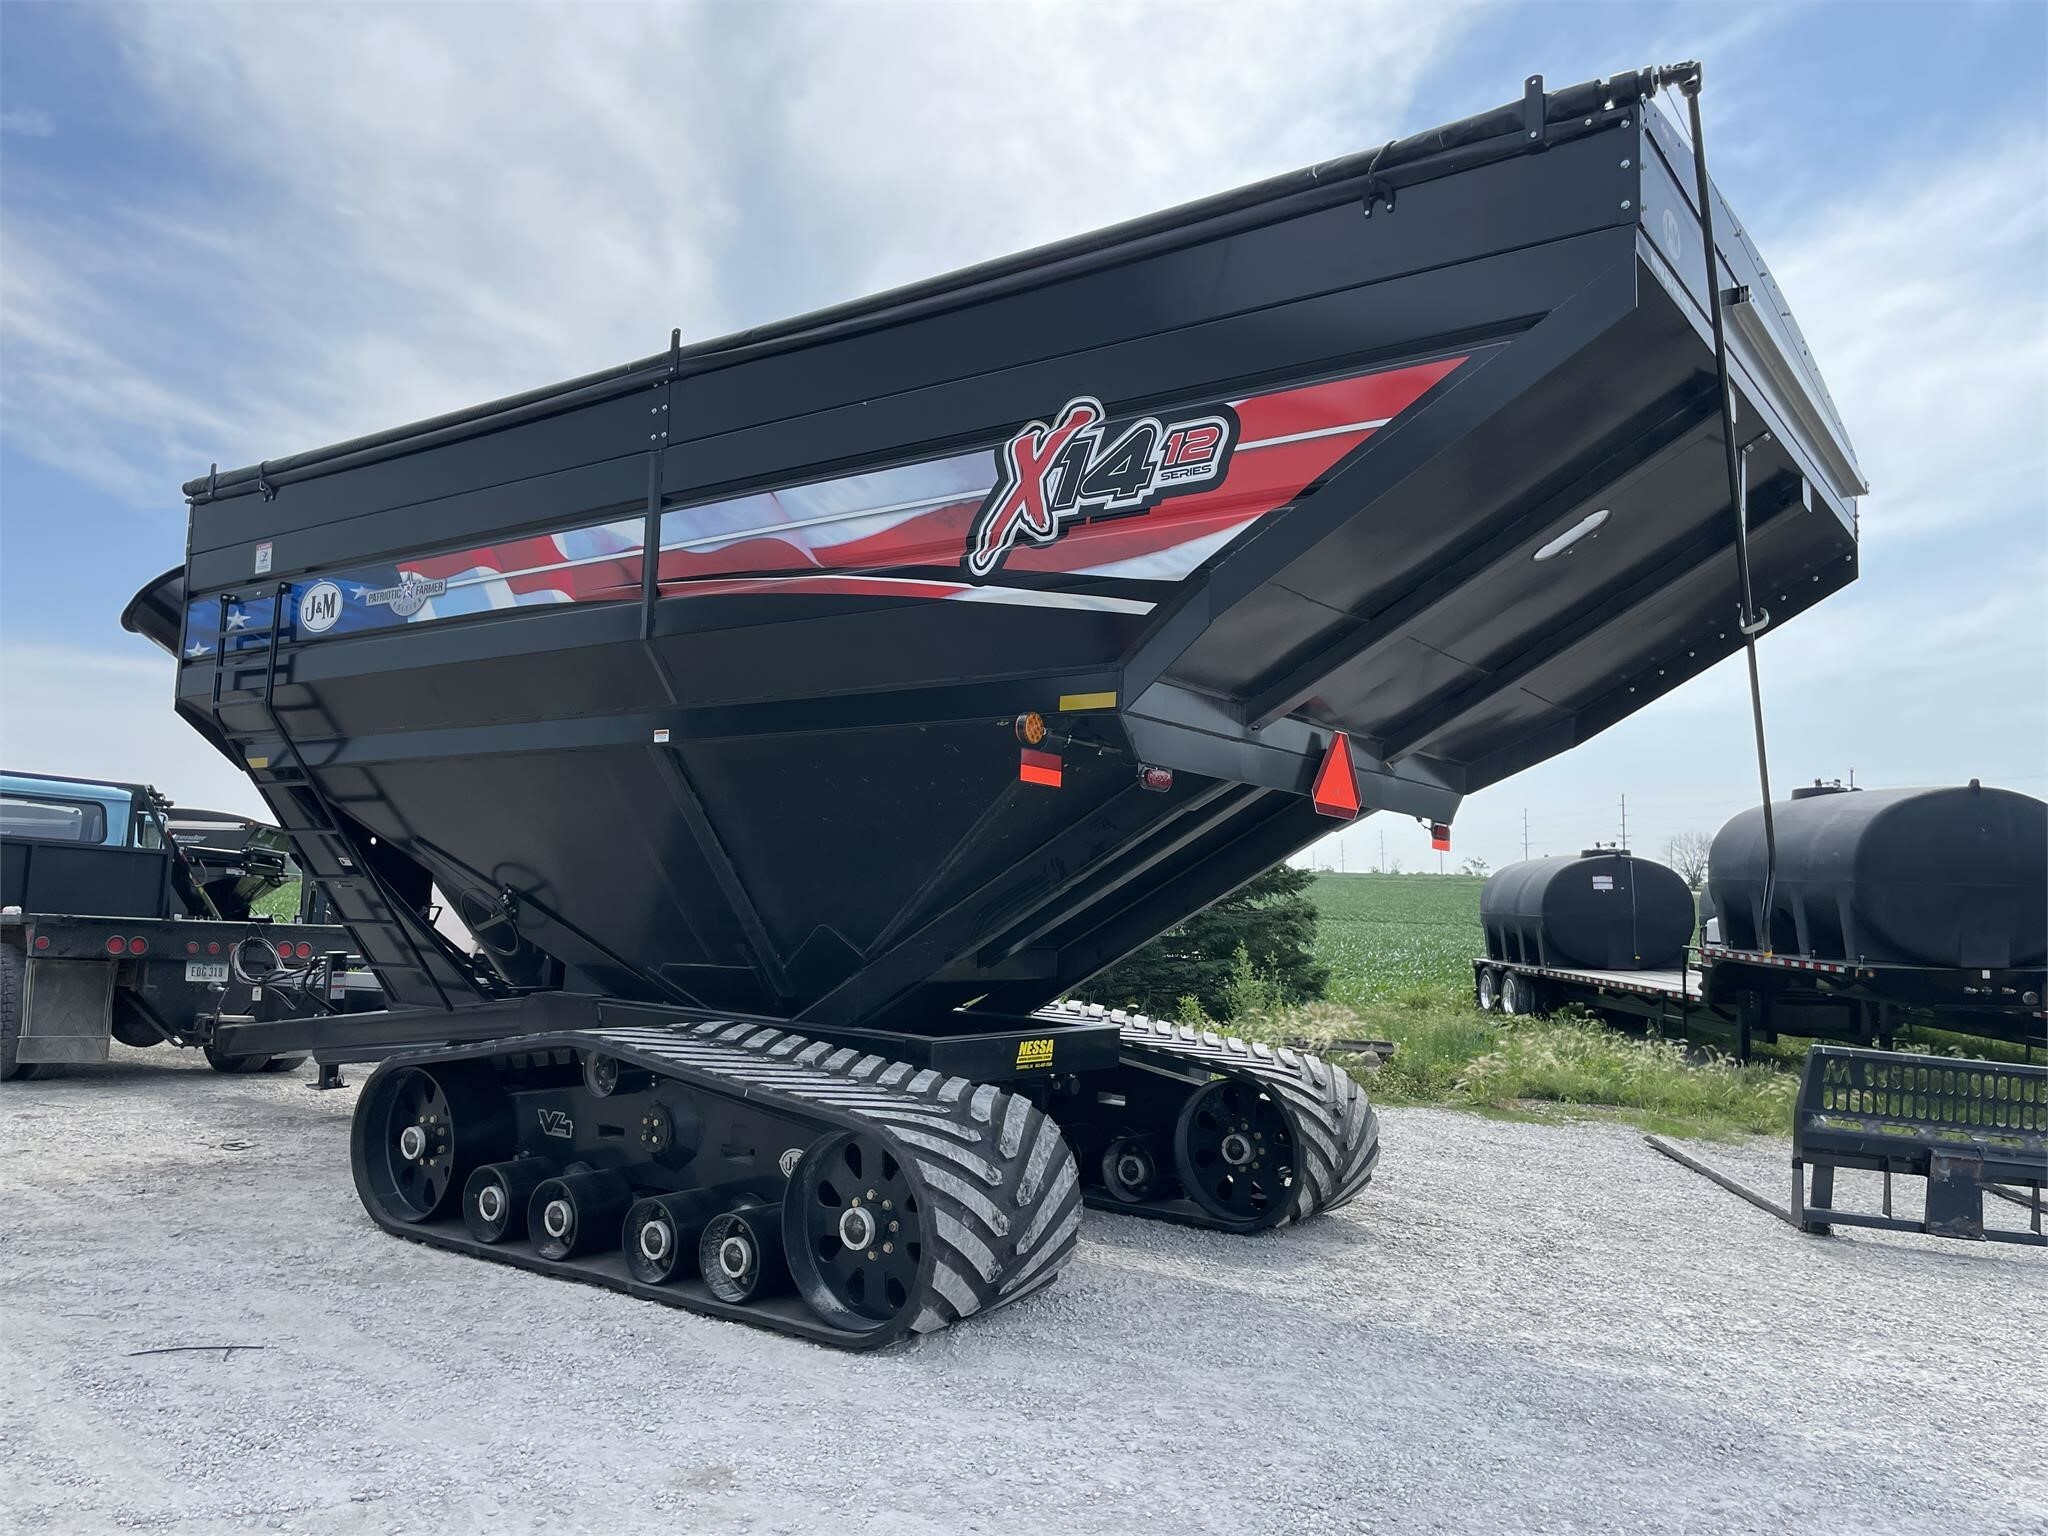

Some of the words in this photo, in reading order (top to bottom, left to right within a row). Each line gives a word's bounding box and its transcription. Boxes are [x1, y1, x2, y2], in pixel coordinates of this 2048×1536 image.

[1165, 426, 1219, 465] 12
[1160, 465, 1212, 481] SERIES
[368, 589, 402, 604] PATRIOTIC
[415, 581, 443, 595] FARMER
[305, 592, 337, 622] J&M
[1018, 1039, 1054, 1055] NESSA
[537, 1108, 573, 1139] V4
